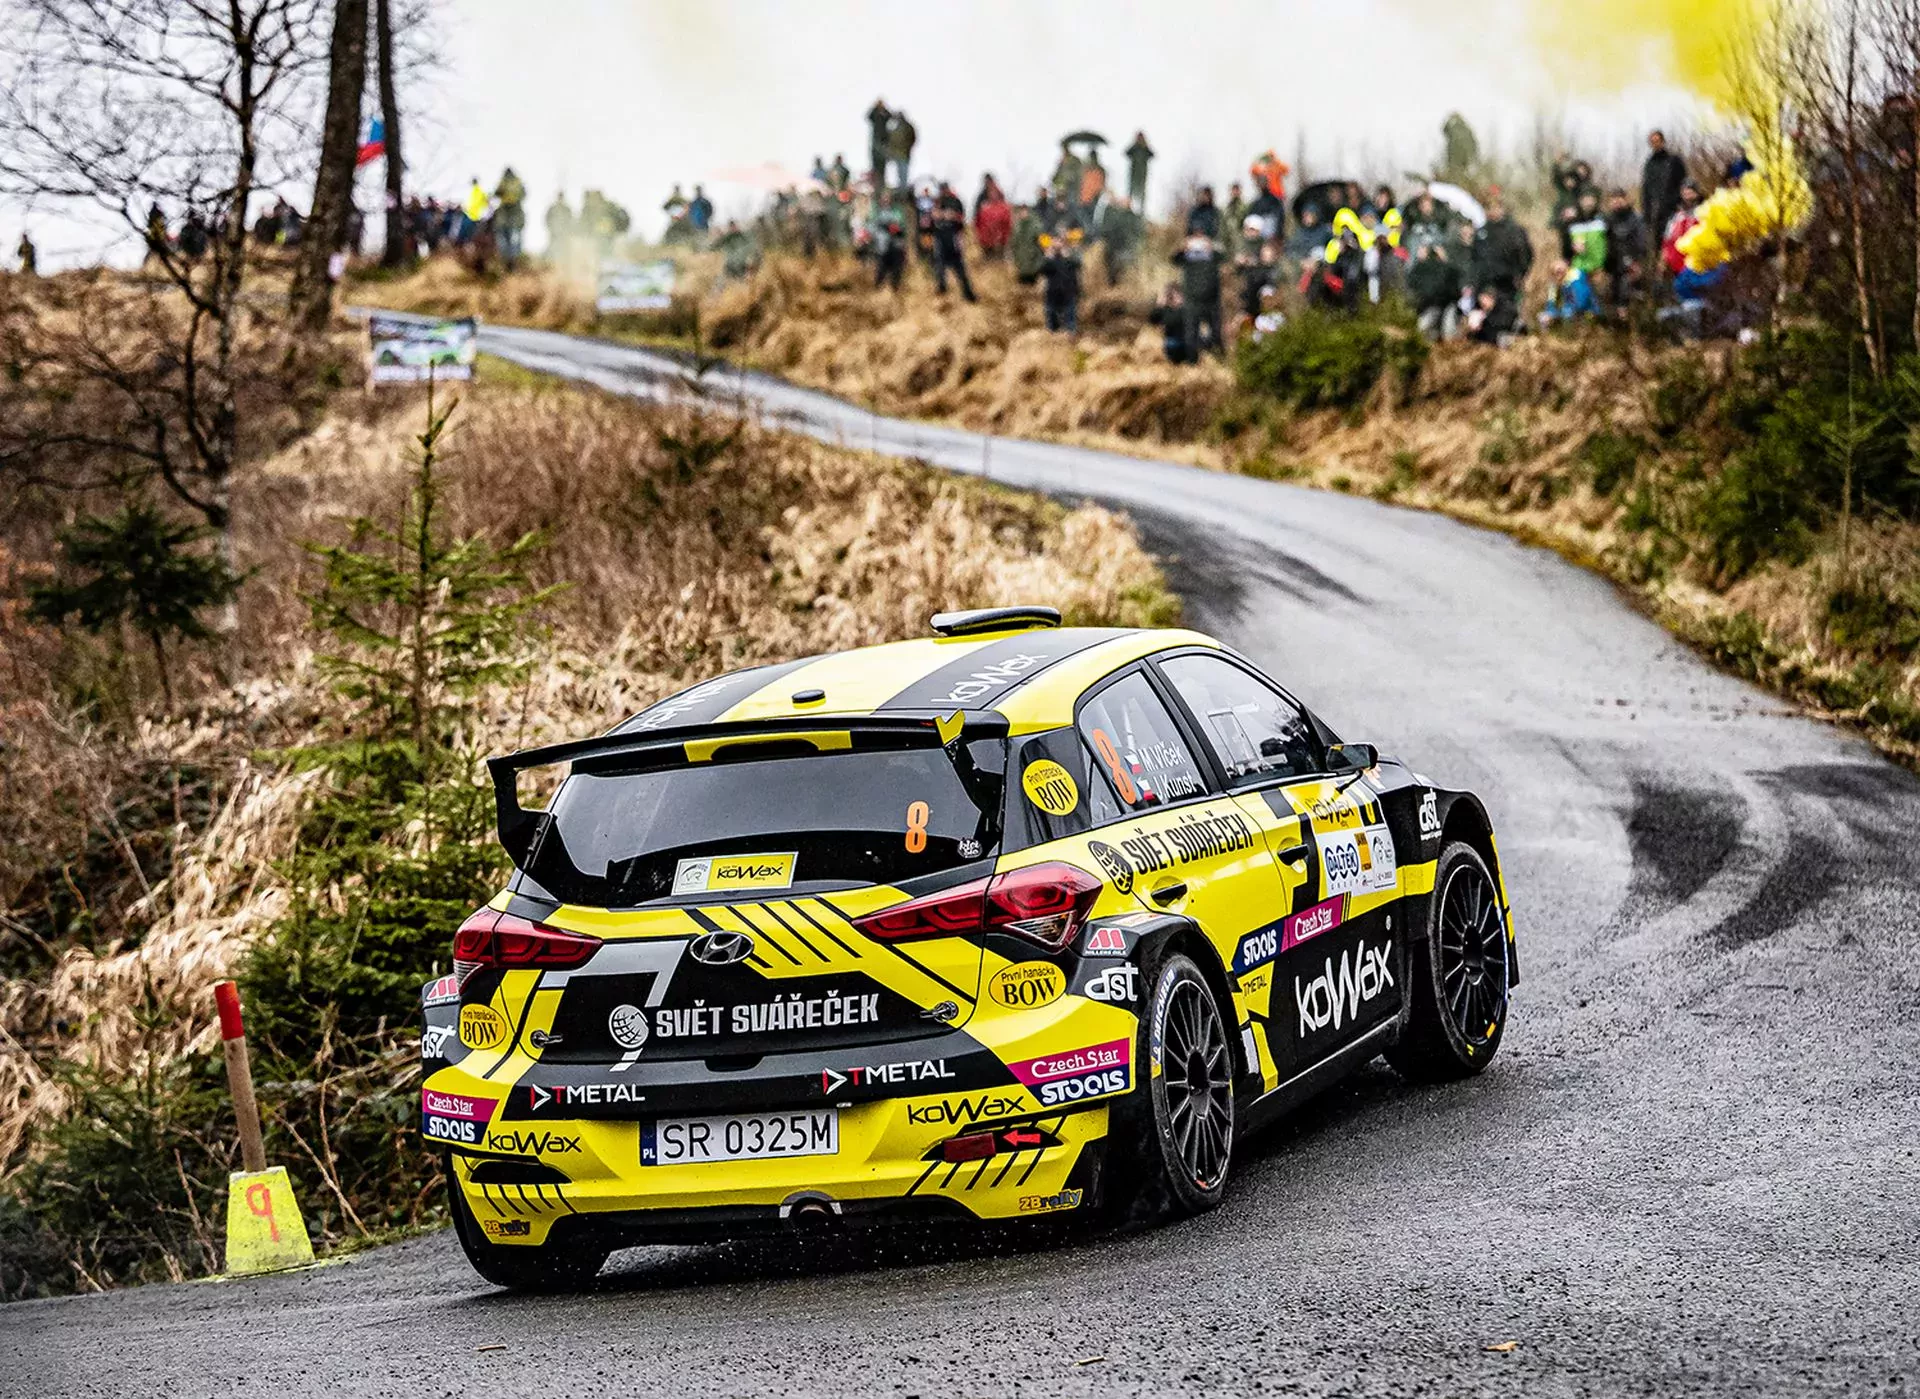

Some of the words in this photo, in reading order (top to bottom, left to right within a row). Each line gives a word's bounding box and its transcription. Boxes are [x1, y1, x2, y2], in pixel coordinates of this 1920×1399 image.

[930, 652, 1048, 703] koWax
[1092, 728, 1136, 805] 8
[905, 801, 929, 854] 8
[1120, 826, 1175, 875] SVĚT
[717, 864, 784, 880] koWax
[1294, 911, 1318, 941] Czech
[1317, 908, 1333, 930] Star
[1002, 977, 1057, 1006] BOW
[1084, 962, 1139, 1001] dst
[1295, 939, 1395, 1038] koWax
[656, 999, 724, 1038] SVĚT
[732, 989, 880, 1034] SVÁŘEČEK
[463, 1021, 499, 1047] BOW
[847, 1059, 956, 1086] TMETAL
[1031, 1054, 1085, 1079] Czech
[1087, 1048, 1121, 1068] Star
[551, 1083, 646, 1104] TMETAL
[1041, 1070, 1125, 1104] STOOLS
[427, 1093, 452, 1113] Czech
[453, 1096, 474, 1116] Star
[907, 1095, 1028, 1125] koWax
[428, 1116, 476, 1142] STOOLS
[487, 1130, 583, 1156] koWax
[662, 1121, 711, 1160] SR
[725, 1114, 832, 1156] 0325M
[643, 1149, 656, 1160] PL
